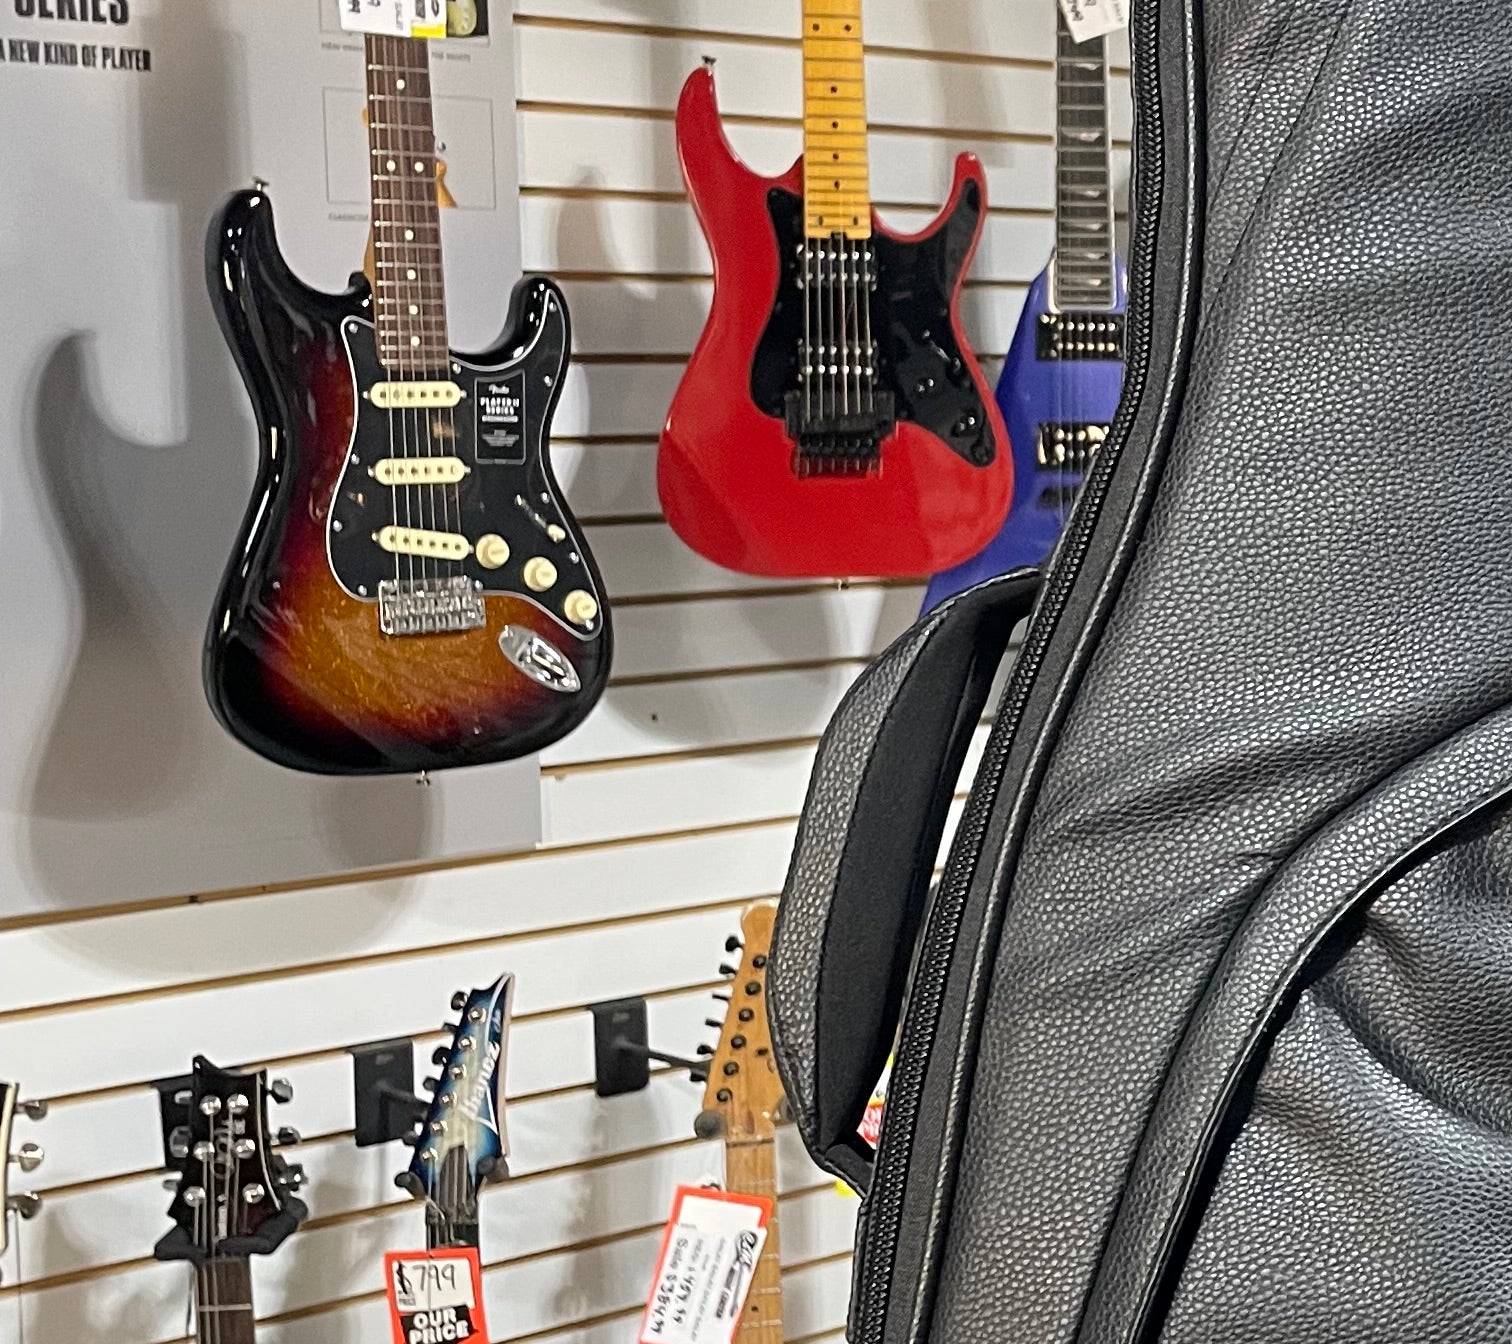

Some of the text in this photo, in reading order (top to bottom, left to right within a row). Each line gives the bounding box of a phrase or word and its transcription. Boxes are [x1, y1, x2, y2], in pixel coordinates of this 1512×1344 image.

[9, 38, 40, 65] NEW
[44, 41, 78, 67] KIND
[82, 44, 97, 68] OF
[102, 46, 152, 72] PLAYER
[412, 1307, 458, 1331] OUR
